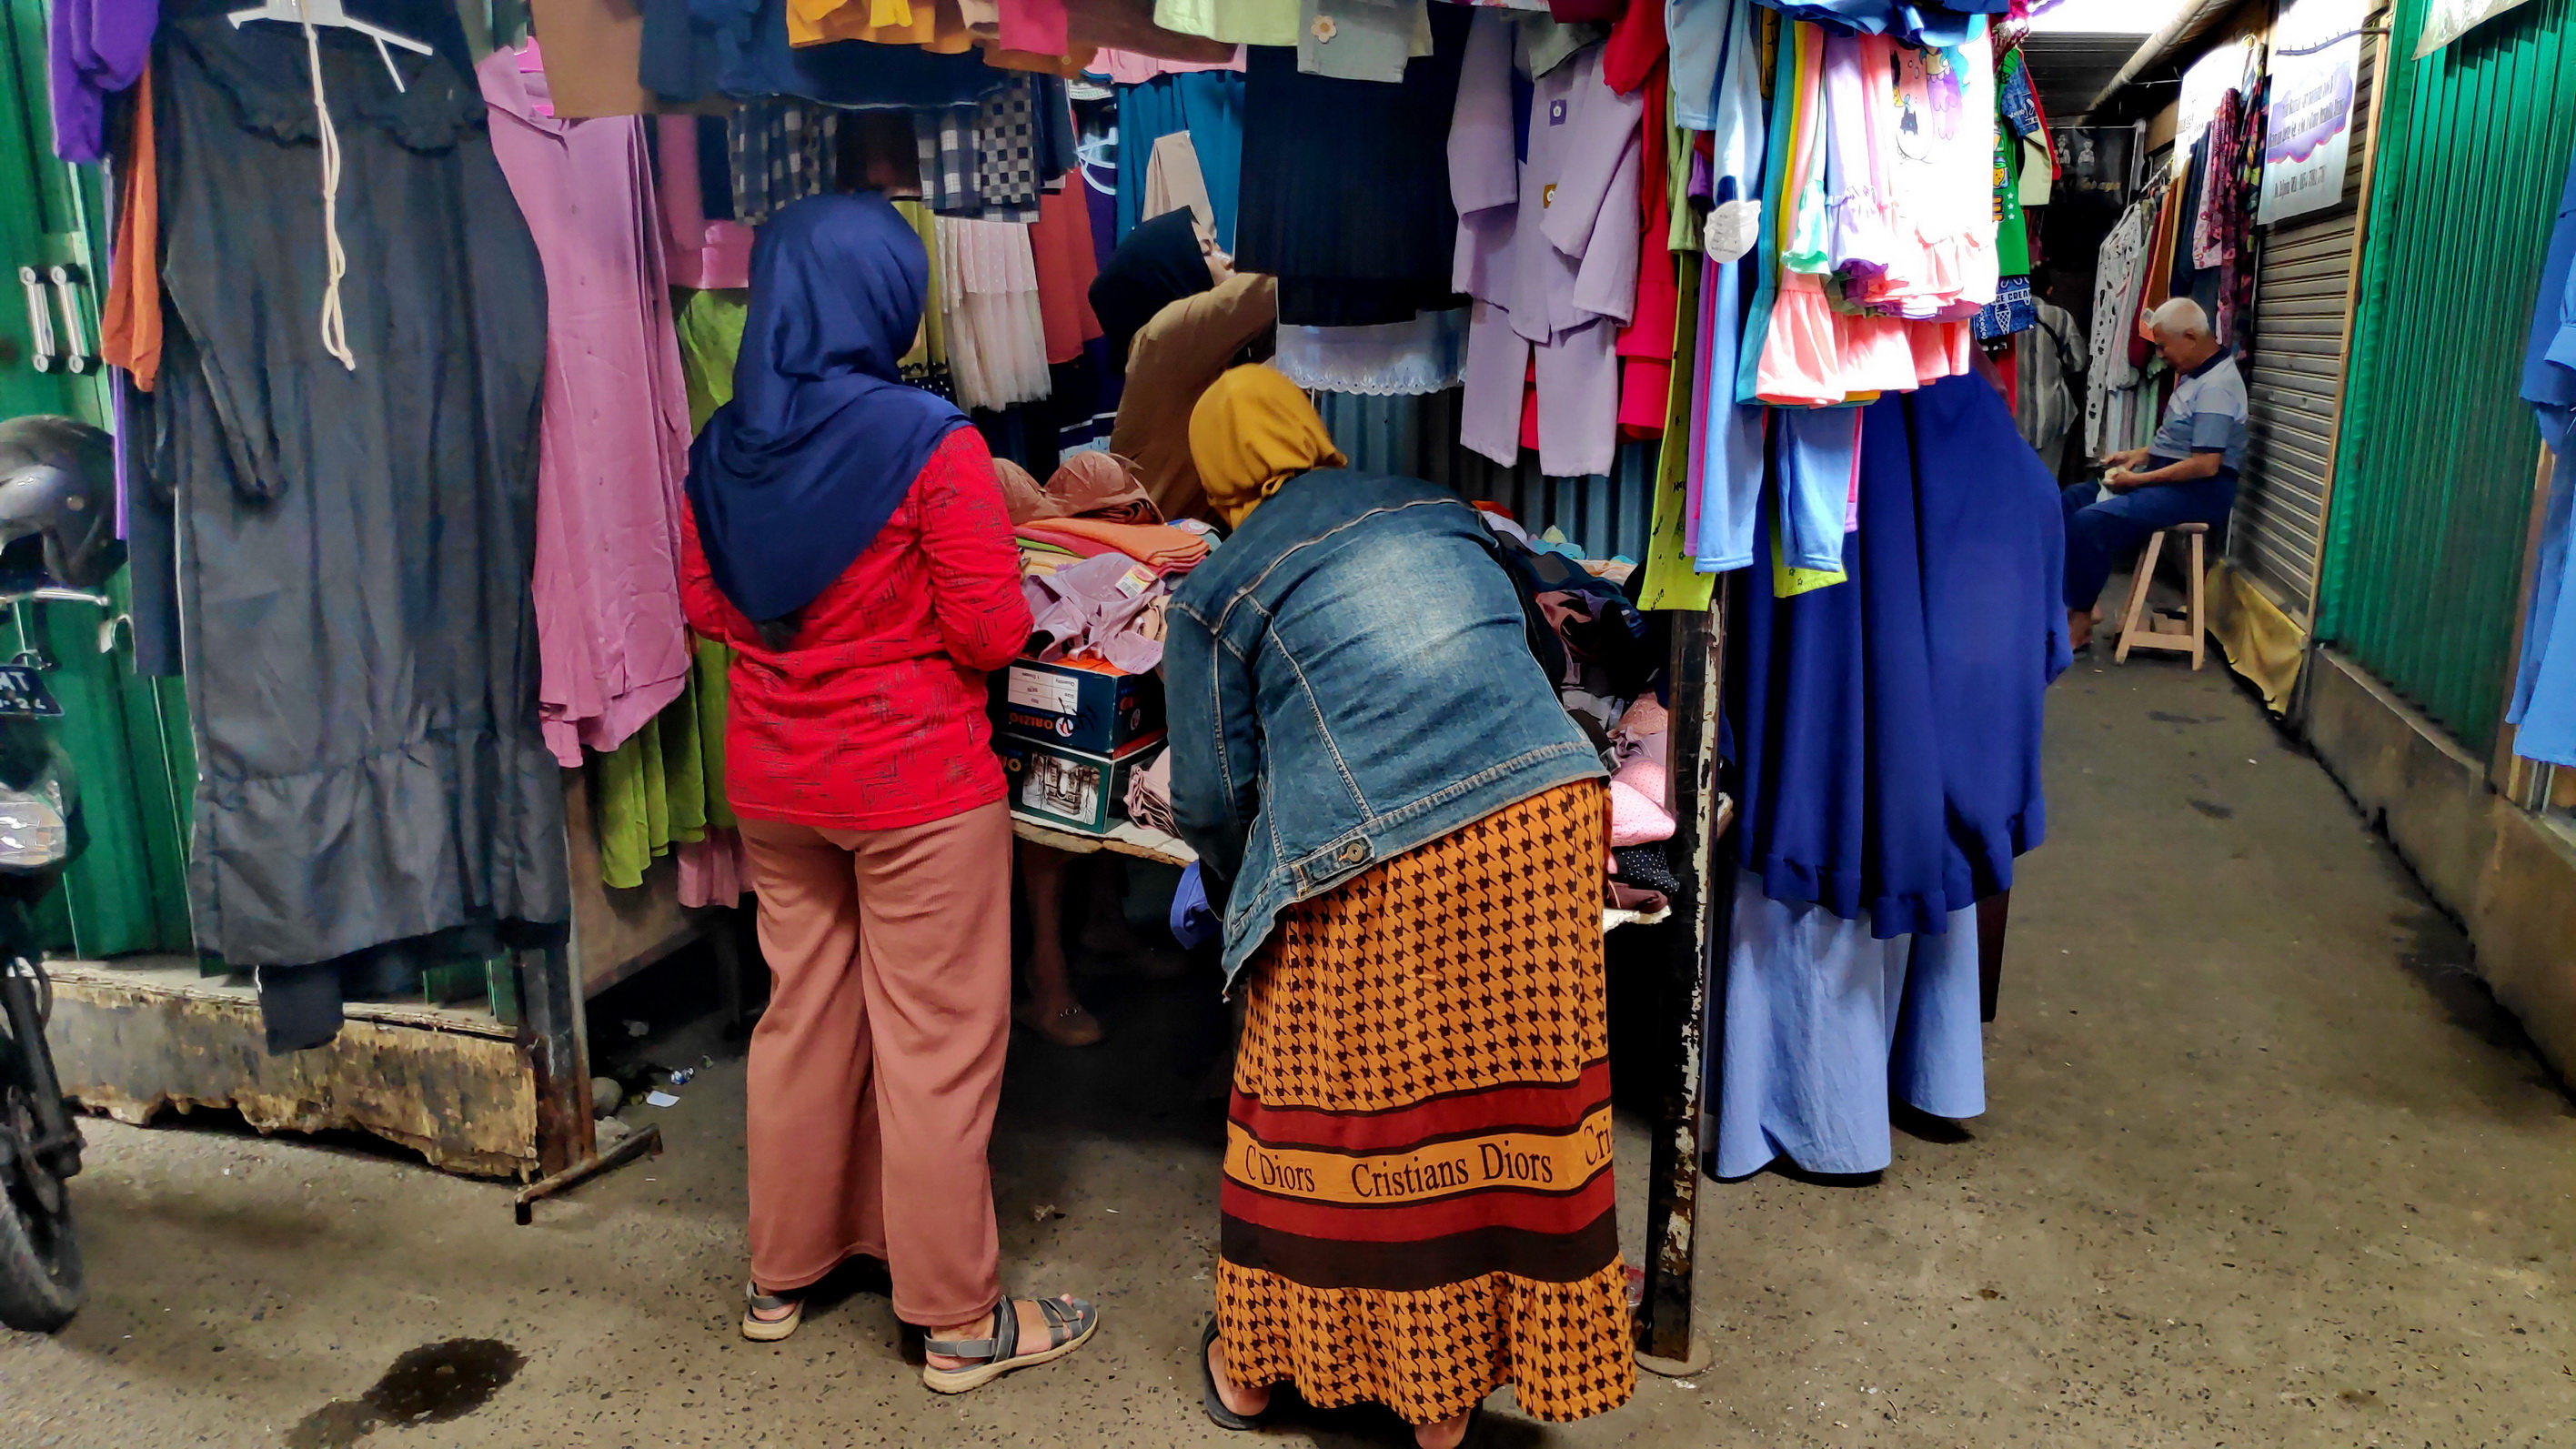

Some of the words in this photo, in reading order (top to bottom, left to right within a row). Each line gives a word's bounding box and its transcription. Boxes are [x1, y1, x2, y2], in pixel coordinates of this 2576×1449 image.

[2007, 289, 2029, 301] CREA
[1258, 1152, 1315, 1192] Diors
[1351, 1155, 1469, 1198] Cristians
[1477, 1139, 1554, 1183] Diors
